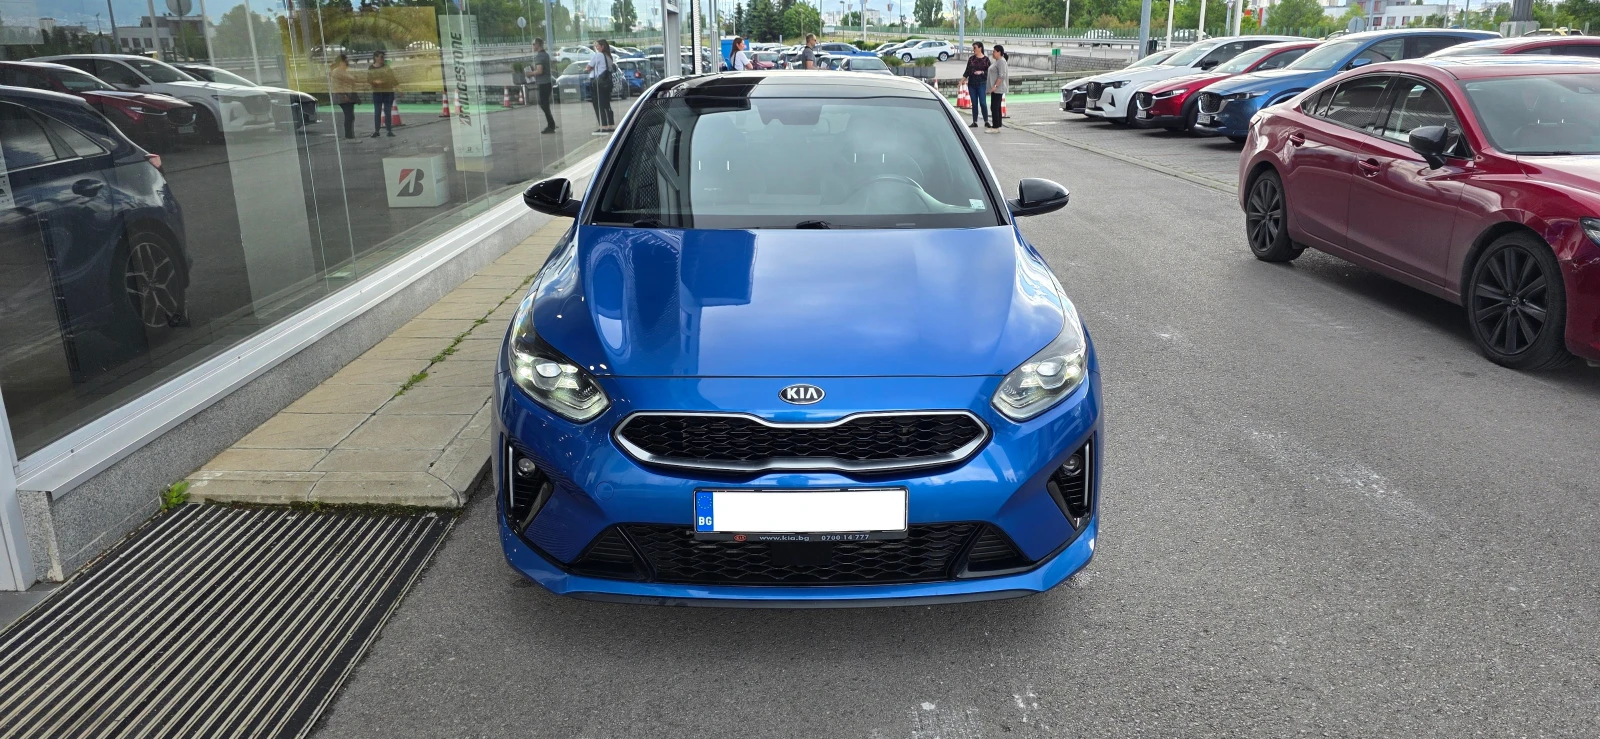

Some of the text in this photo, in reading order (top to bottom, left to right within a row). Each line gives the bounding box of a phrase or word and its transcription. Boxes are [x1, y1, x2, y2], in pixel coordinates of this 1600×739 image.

[450, 32, 472, 127] BRIDGESTONE
[786, 387, 818, 400] KIA
[698, 516, 712, 526] BG
[759, 534, 810, 542] www.kia.bg
